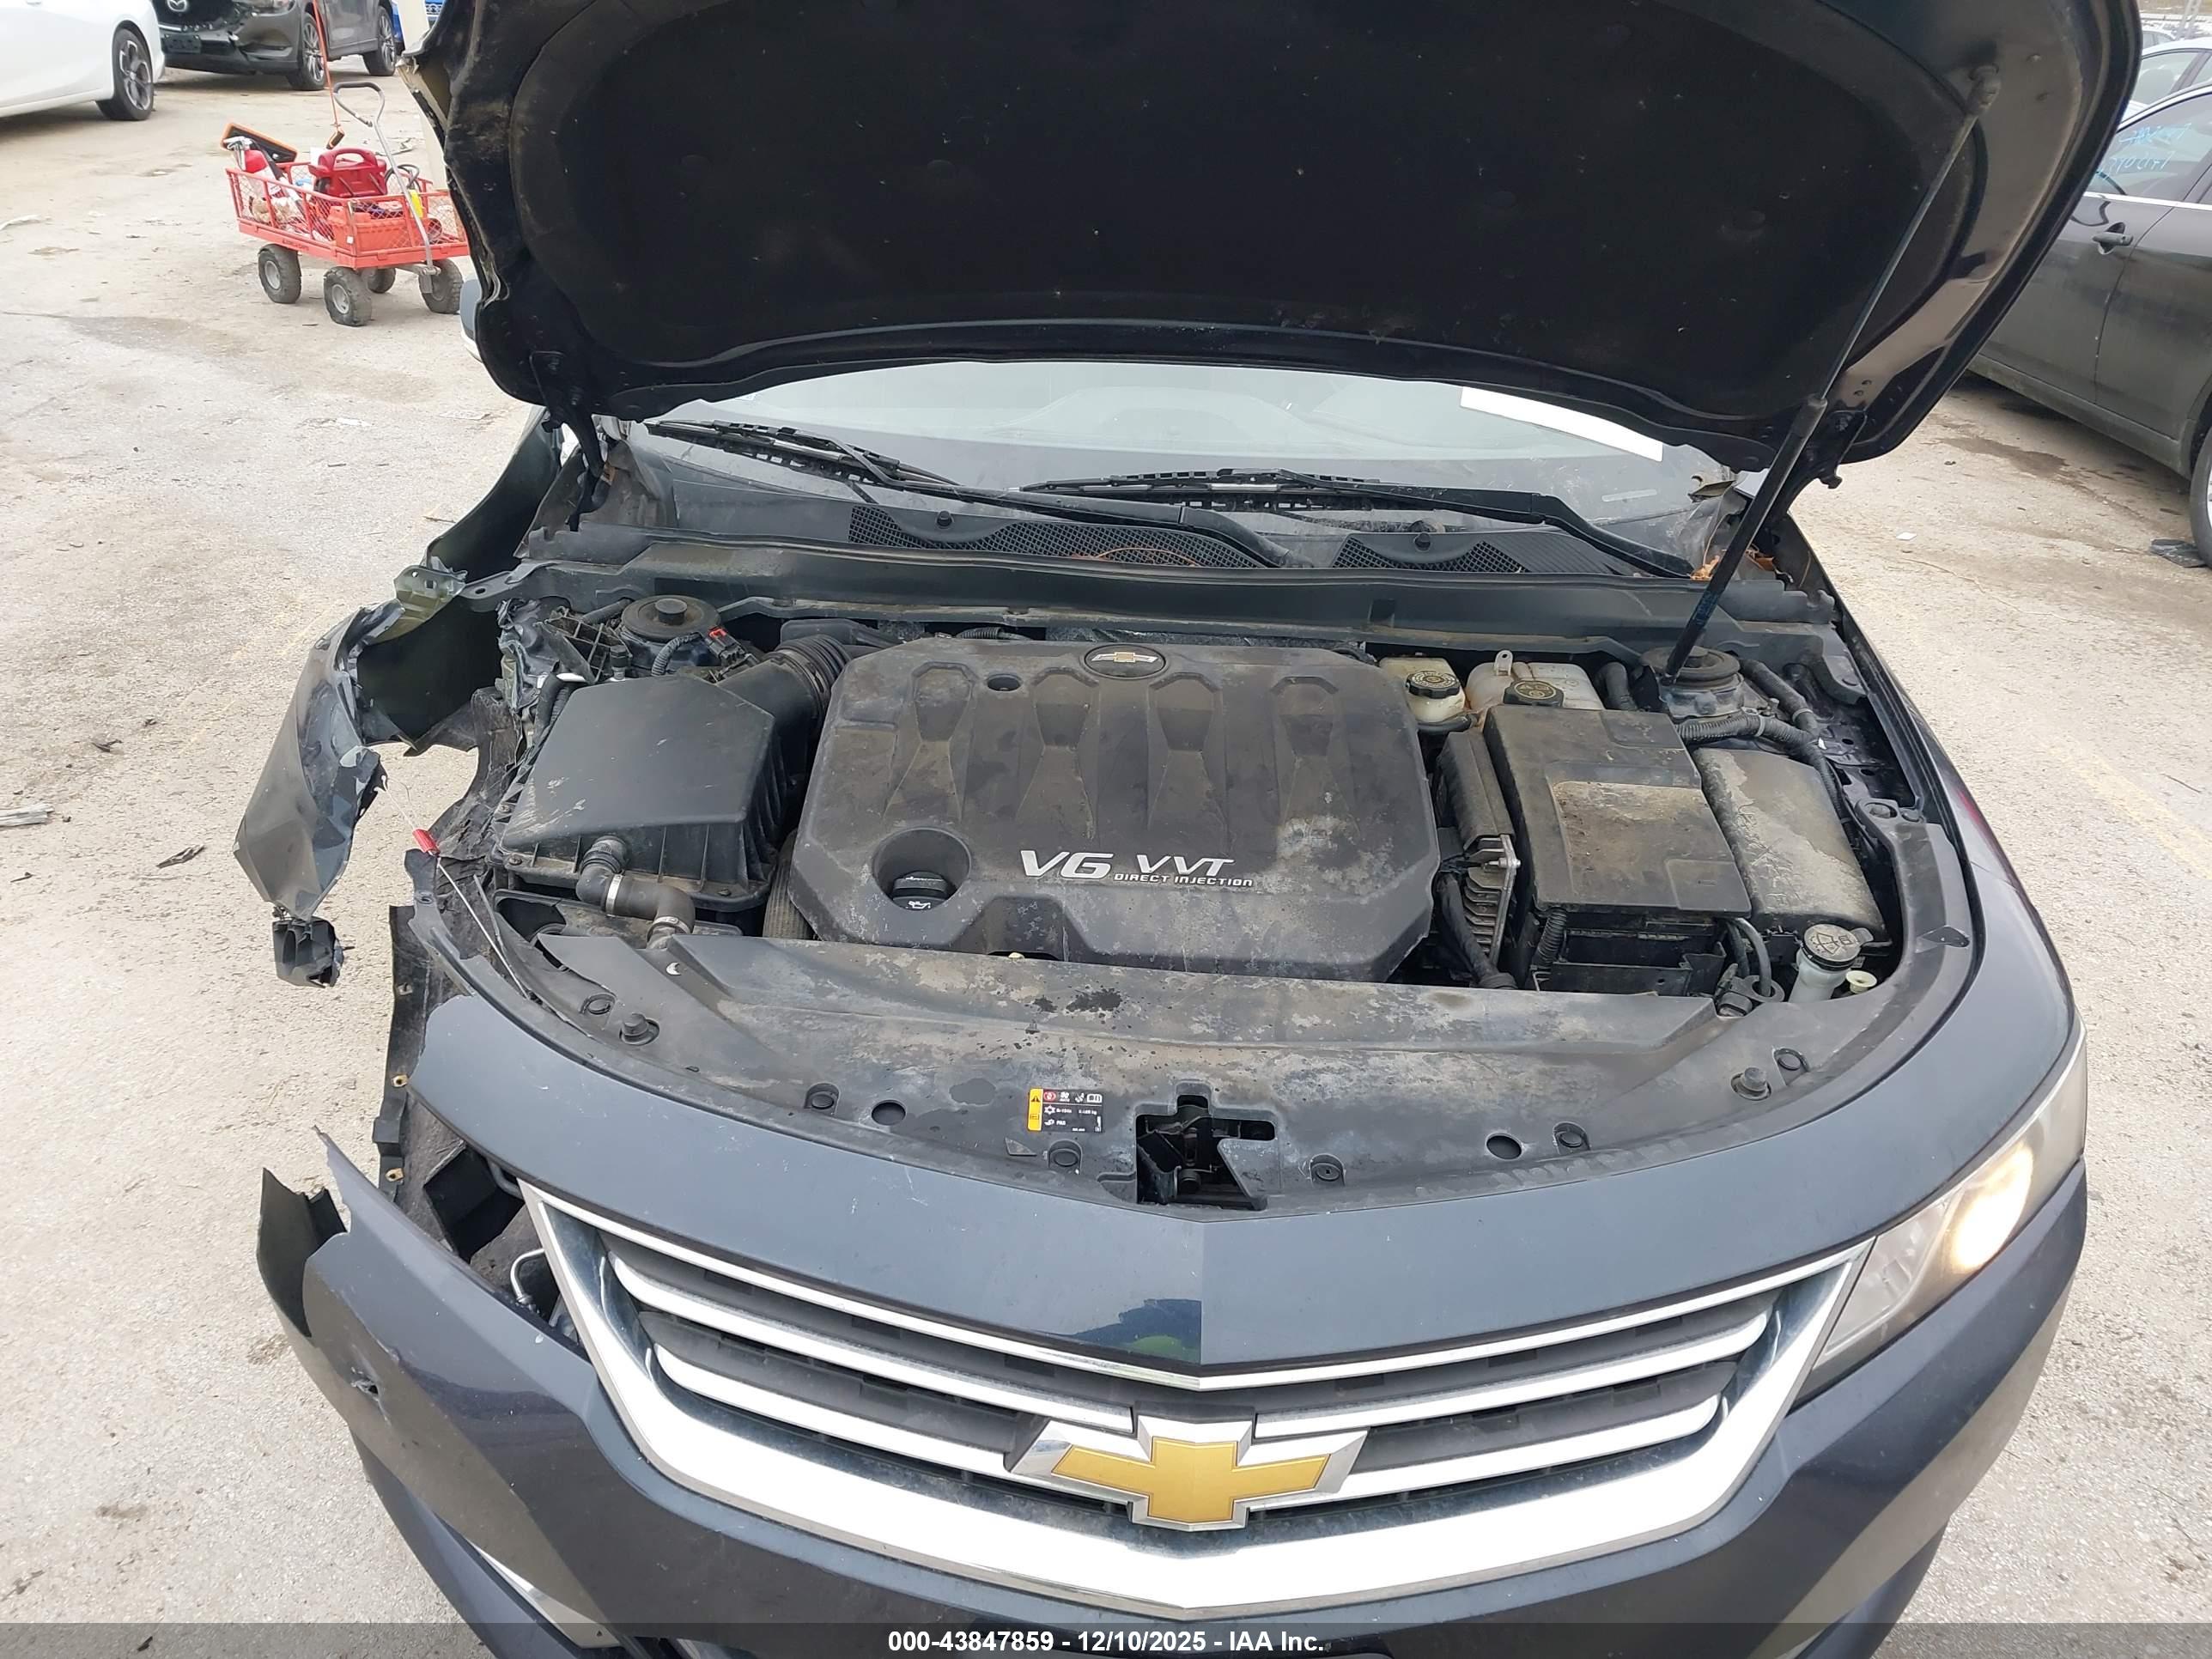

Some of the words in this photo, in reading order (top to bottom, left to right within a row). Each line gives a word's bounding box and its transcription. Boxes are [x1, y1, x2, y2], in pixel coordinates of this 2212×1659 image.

[1019, 850, 1115, 879] V6
[1136, 854, 1236, 877] VVT
[1114, 873, 1170, 884] DIRECT
[1175, 876, 1254, 887] INJECTION
